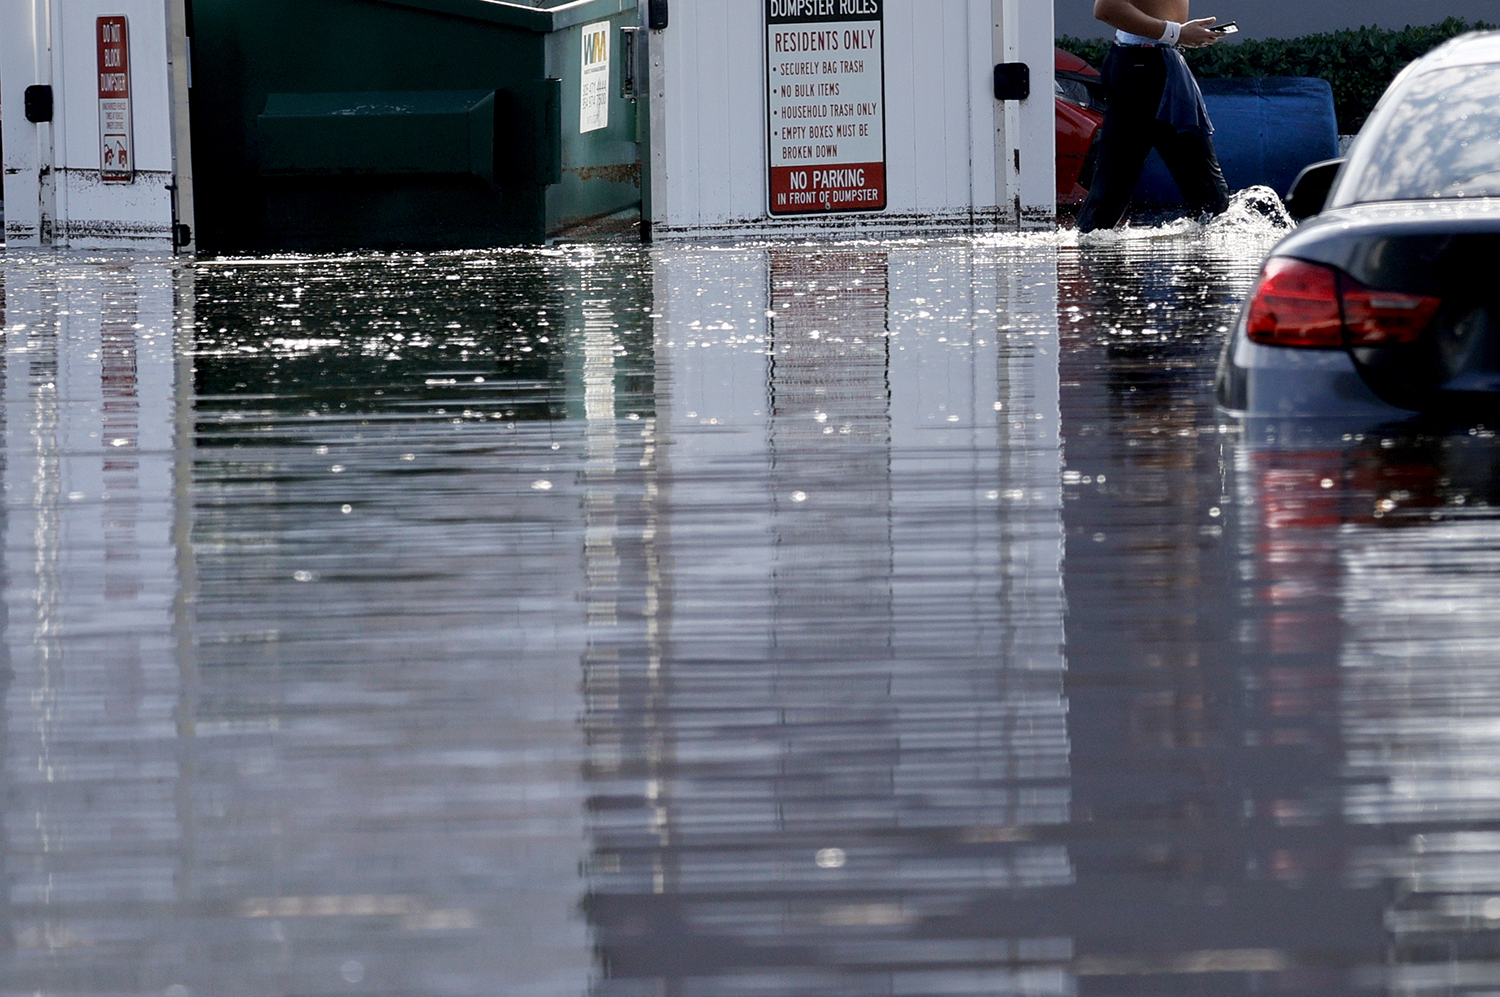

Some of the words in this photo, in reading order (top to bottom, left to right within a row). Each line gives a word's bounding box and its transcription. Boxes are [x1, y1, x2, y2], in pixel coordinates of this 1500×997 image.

[102, 24, 111, 43] DO
[111, 24, 121, 42] NOT
[775, 31, 839, 52] RESIDENTS
[843, 29, 875, 50] ONLY
[584, 30, 607, 65] WM
[104, 49, 121, 67] BLOCK
[780, 61, 819, 76] SECURELY
[822, 61, 838, 75] BAG
[840, 60, 864, 73] TRASH
[100, 73, 126, 92] DUMPSTER
[780, 85, 792, 98] NO
[795, 84, 815, 97] BULK
[818, 83, 840, 96] ITEMS
[781, 105, 827, 119] HOUSEHOLD
[830, 104, 854, 117] TRASH
[857, 102, 877, 116] ONLY
[782, 127, 806, 140] EMPTY
[809, 125, 833, 138] BOXES
[836, 124, 856, 137] MUST
[859, 124, 869, 137] BE
[782, 146, 813, 160] BROKEN
[815, 144, 838, 158] DOWN
[790, 171, 807, 190] NO
[813, 169, 865, 189] PARKING
[777, 193, 787, 205] IN
[789, 191, 816, 204] FRONT
[819, 190, 830, 203] OF
[833, 189, 878, 202] DUMPSTER
